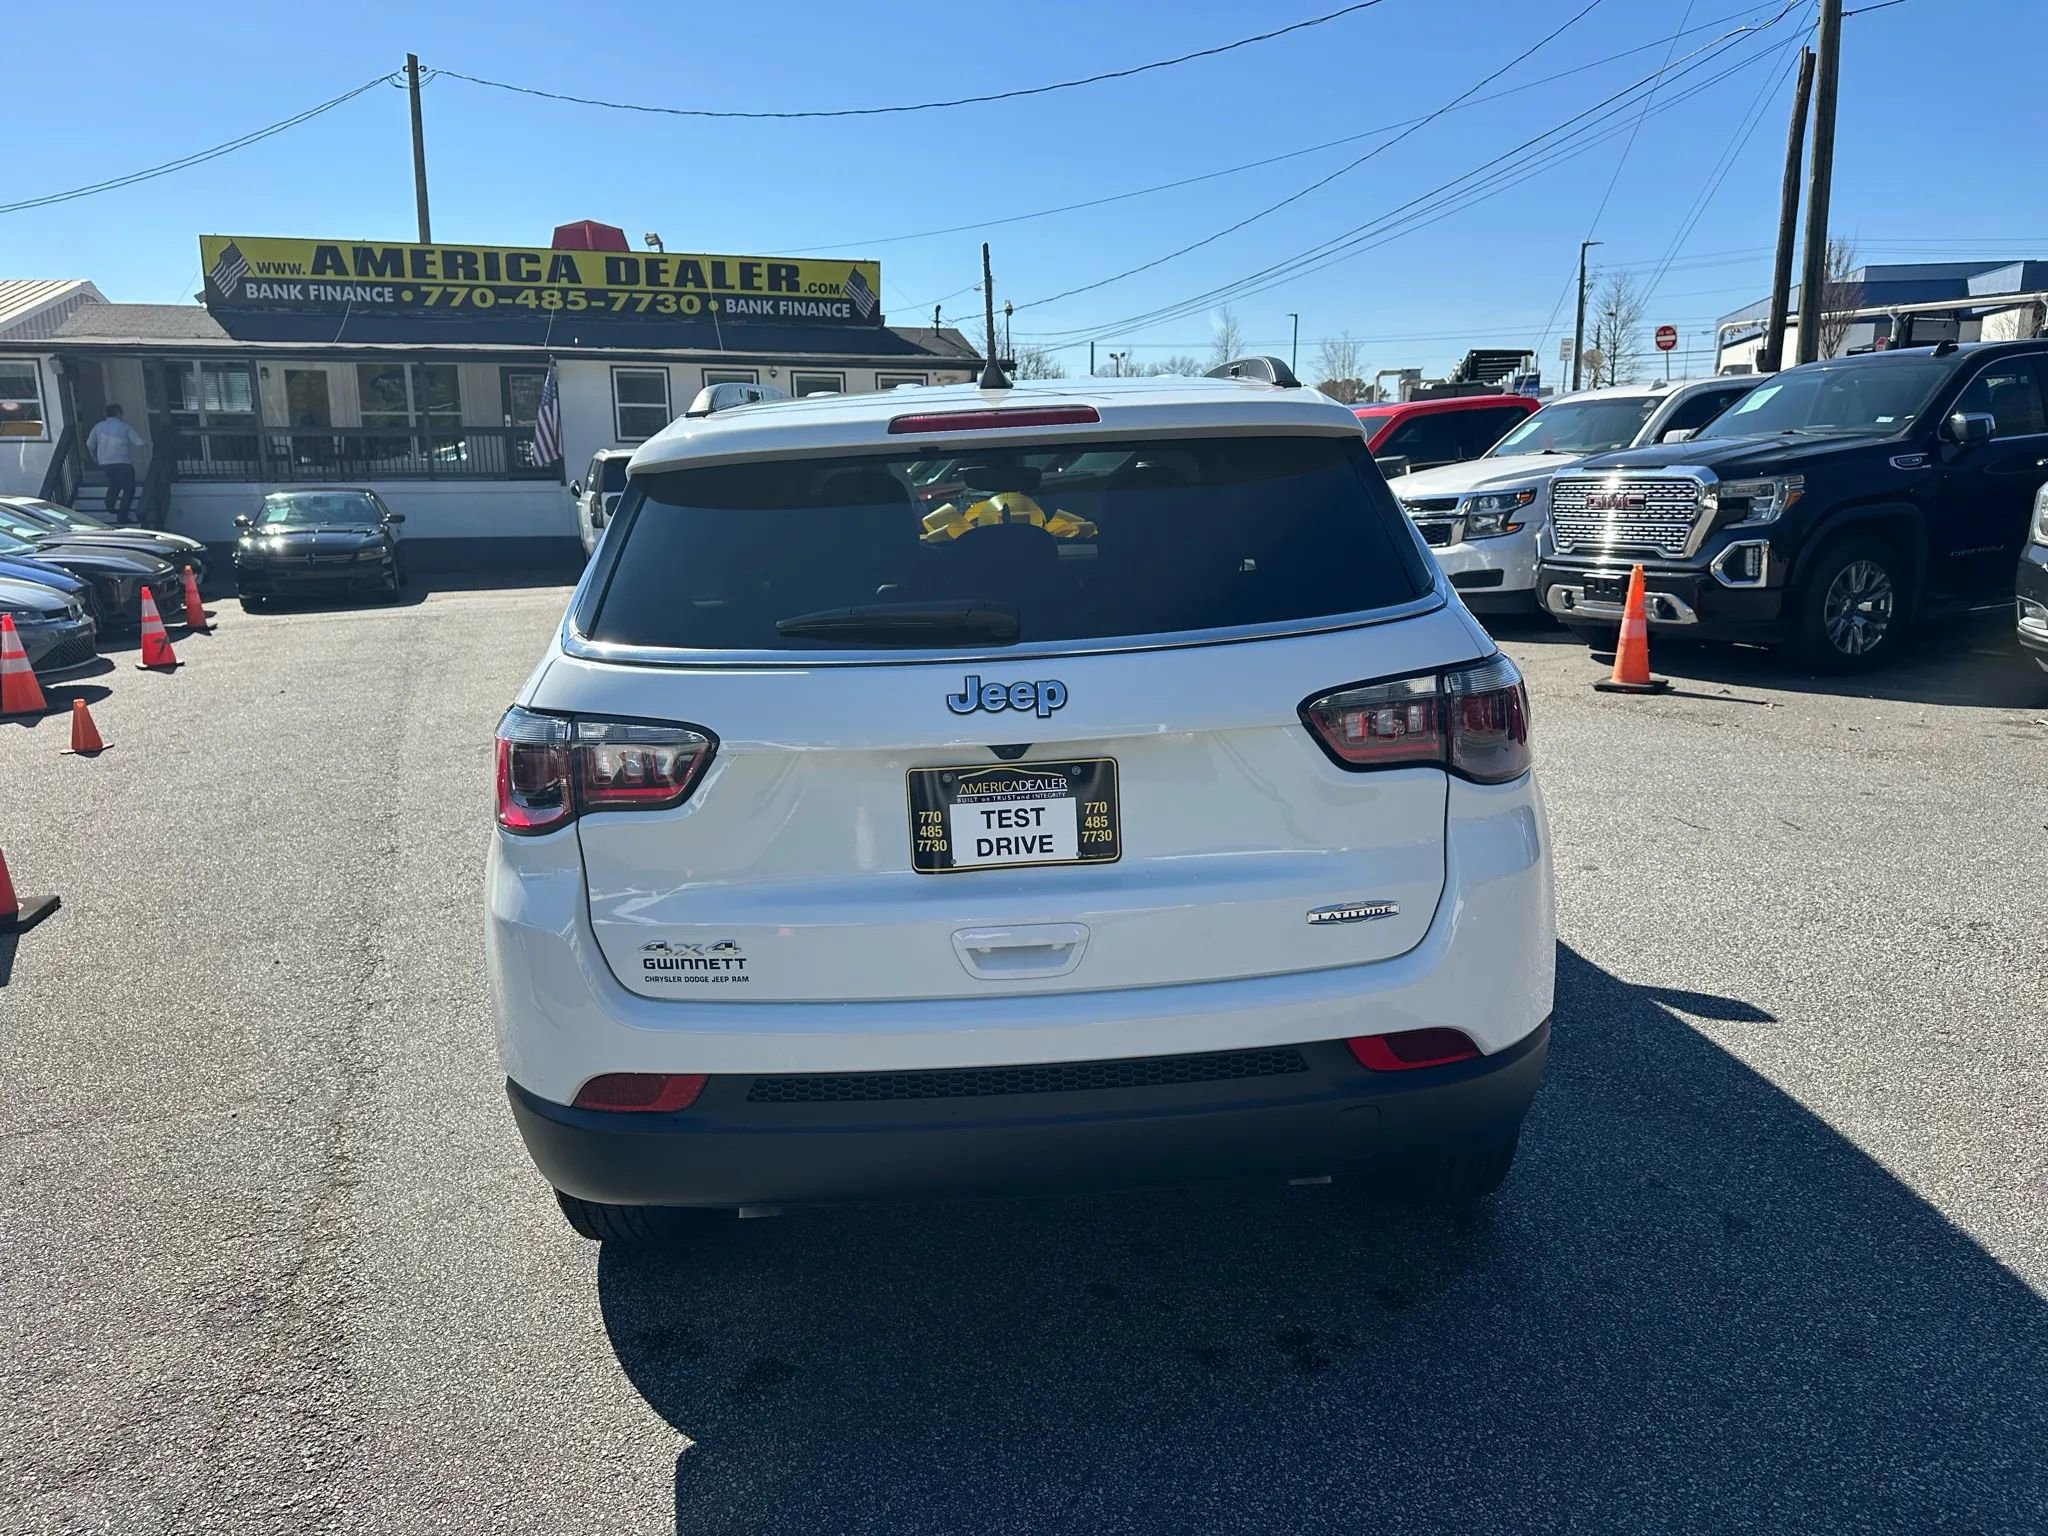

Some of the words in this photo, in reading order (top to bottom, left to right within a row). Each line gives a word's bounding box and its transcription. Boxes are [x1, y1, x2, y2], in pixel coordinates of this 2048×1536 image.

[310, 245, 582, 283] AMERICA
[605, 256, 800, 292] DEALER
[246, 283, 303, 300] BANK
[309, 284, 394, 303] FINANCE
[726, 298, 774, 315] BANK
[779, 300, 850, 318] FINANCE
[1587, 493, 1645, 510] GMC
[946, 675, 1068, 719] Jeep
[1084, 801, 1108, 814] 770
[919, 811, 942, 824] 770
[980, 807, 1046, 830] TEST
[1085, 816, 1108, 829] 485
[919, 825, 943, 838] 485
[1082, 829, 1113, 843] 7730
[917, 839, 948, 852] 7730
[976, 834, 1054, 857] DRIVE
[1318, 906, 1392, 920] LATITUDE
[643, 958, 747, 970] GWINNETT
[645, 975, 682, 983] CHRYSLER
[684, 975, 709, 983] DODGE
[711, 975, 729, 983] JEEP
[731, 975, 749, 983] RAM
